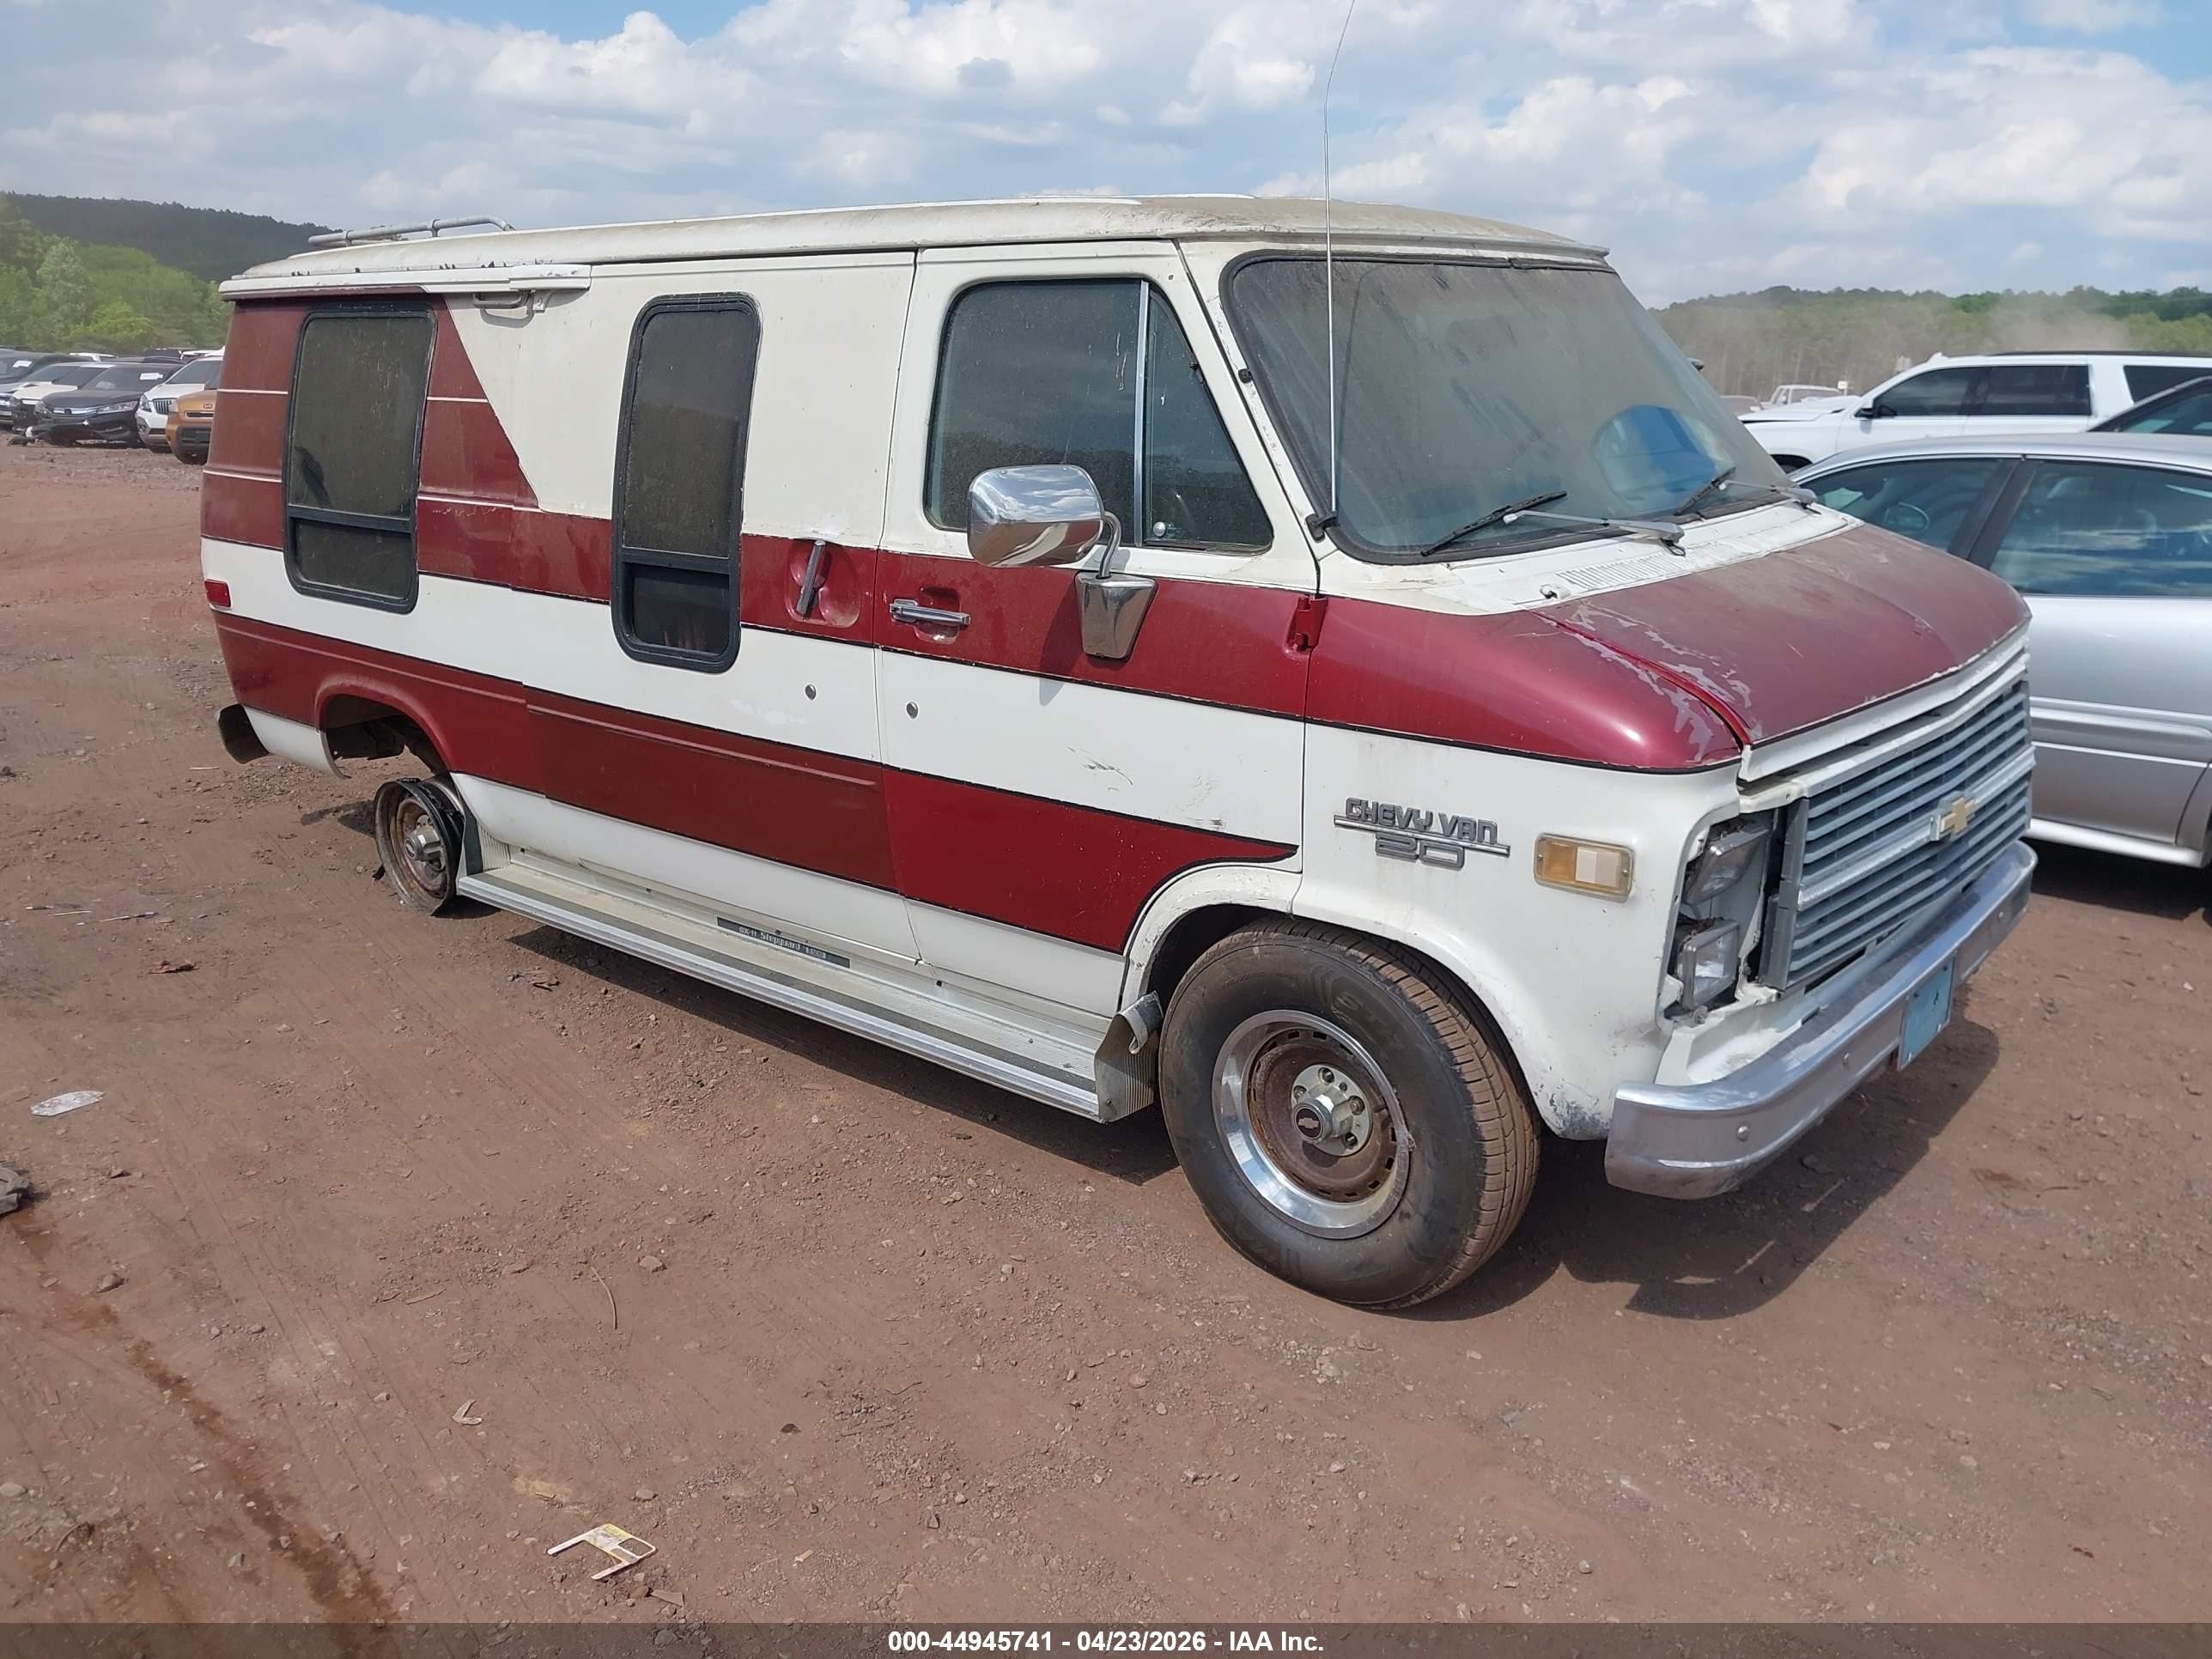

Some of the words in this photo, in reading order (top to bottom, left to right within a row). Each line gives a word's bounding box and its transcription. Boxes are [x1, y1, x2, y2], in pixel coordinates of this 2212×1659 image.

[1346, 797, 1433, 832] CHEVY
[1438, 812, 1498, 845] VAN
[1375, 831, 1465, 871] 20
